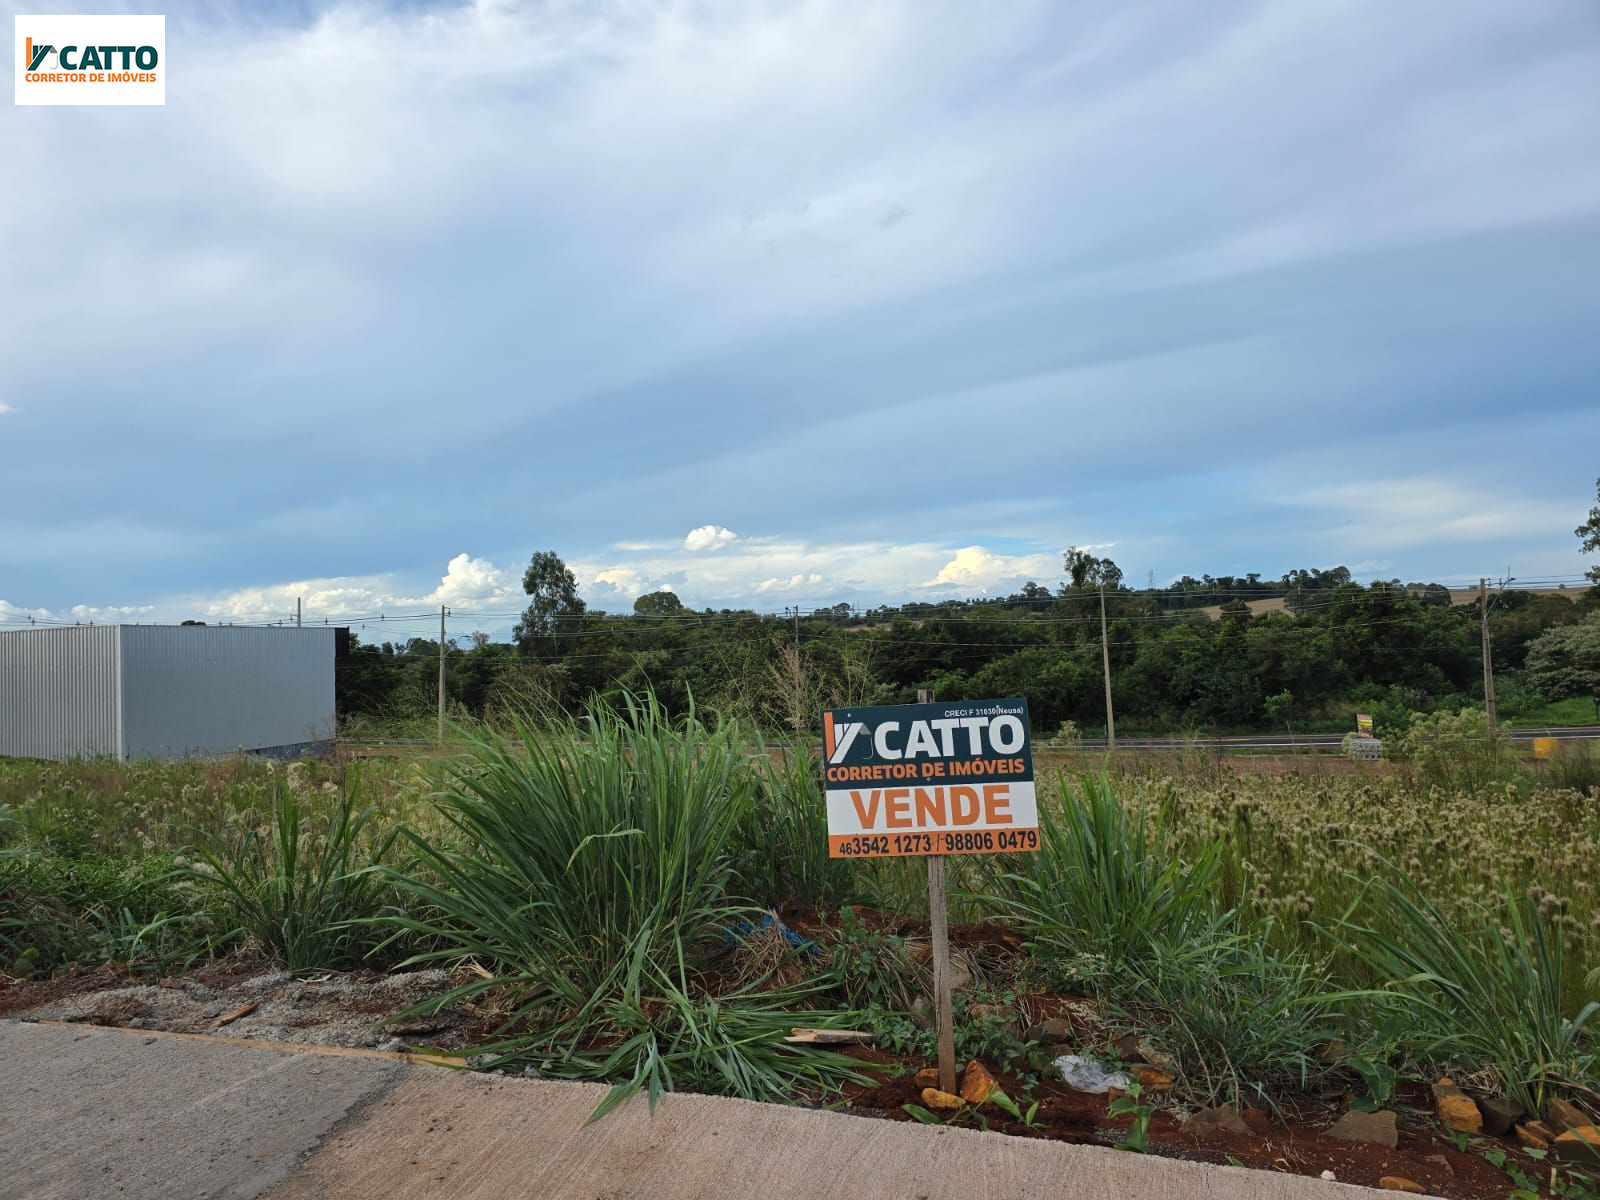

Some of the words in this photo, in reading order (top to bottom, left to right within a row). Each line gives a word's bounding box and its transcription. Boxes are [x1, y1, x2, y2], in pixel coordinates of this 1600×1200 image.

[944, 709, 968, 717] CRECI
[874, 715, 1025, 760] CATTO
[827, 763, 918, 782] CORRETOR
[921, 762, 946, 778] DE
[949, 757, 1025, 776] IMÓVEIS
[849, 784, 1014, 829] VENDE
[894, 834, 932, 853] 1273
[945, 832, 993, 851] 98806
[998, 830, 1037, 850] 0479
